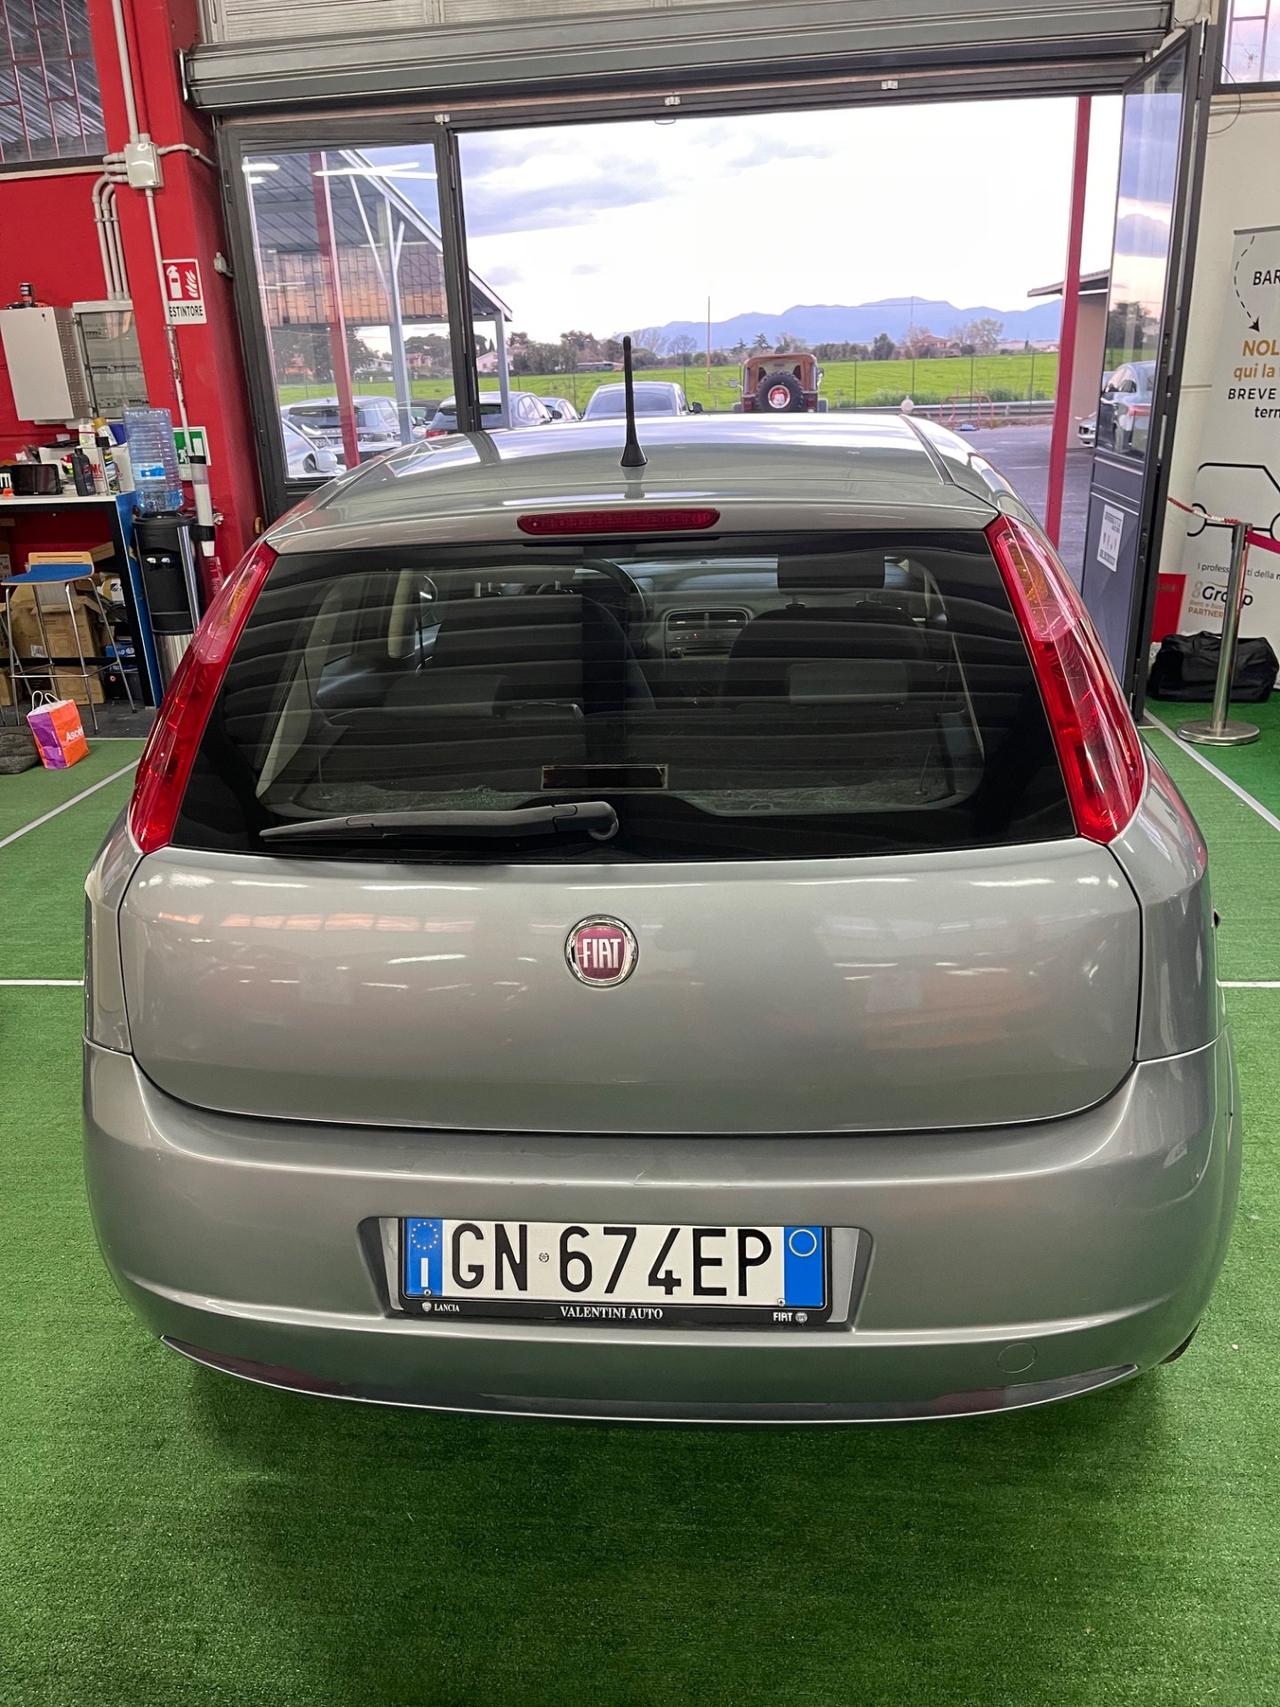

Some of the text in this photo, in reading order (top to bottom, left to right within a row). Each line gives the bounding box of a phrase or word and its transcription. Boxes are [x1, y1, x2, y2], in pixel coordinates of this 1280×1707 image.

[1253, 270, 1280, 286] BAR
[169, 305, 204, 317] ESTINTORE
[1242, 339, 1280, 357] NOL
[1233, 363, 1258, 382] qui
[1262, 363, 1275, 378] la
[1228, 387, 1277, 400] BREVE
[582, 938, 622, 969] FIAT
[451, 1222, 772, 1297] GN 674EP
[434, 1303, 460, 1313] LANCIA
[560, 1306, 664, 1320] VALENTINI AUTO
[773, 1311, 794, 1322] FIAT
